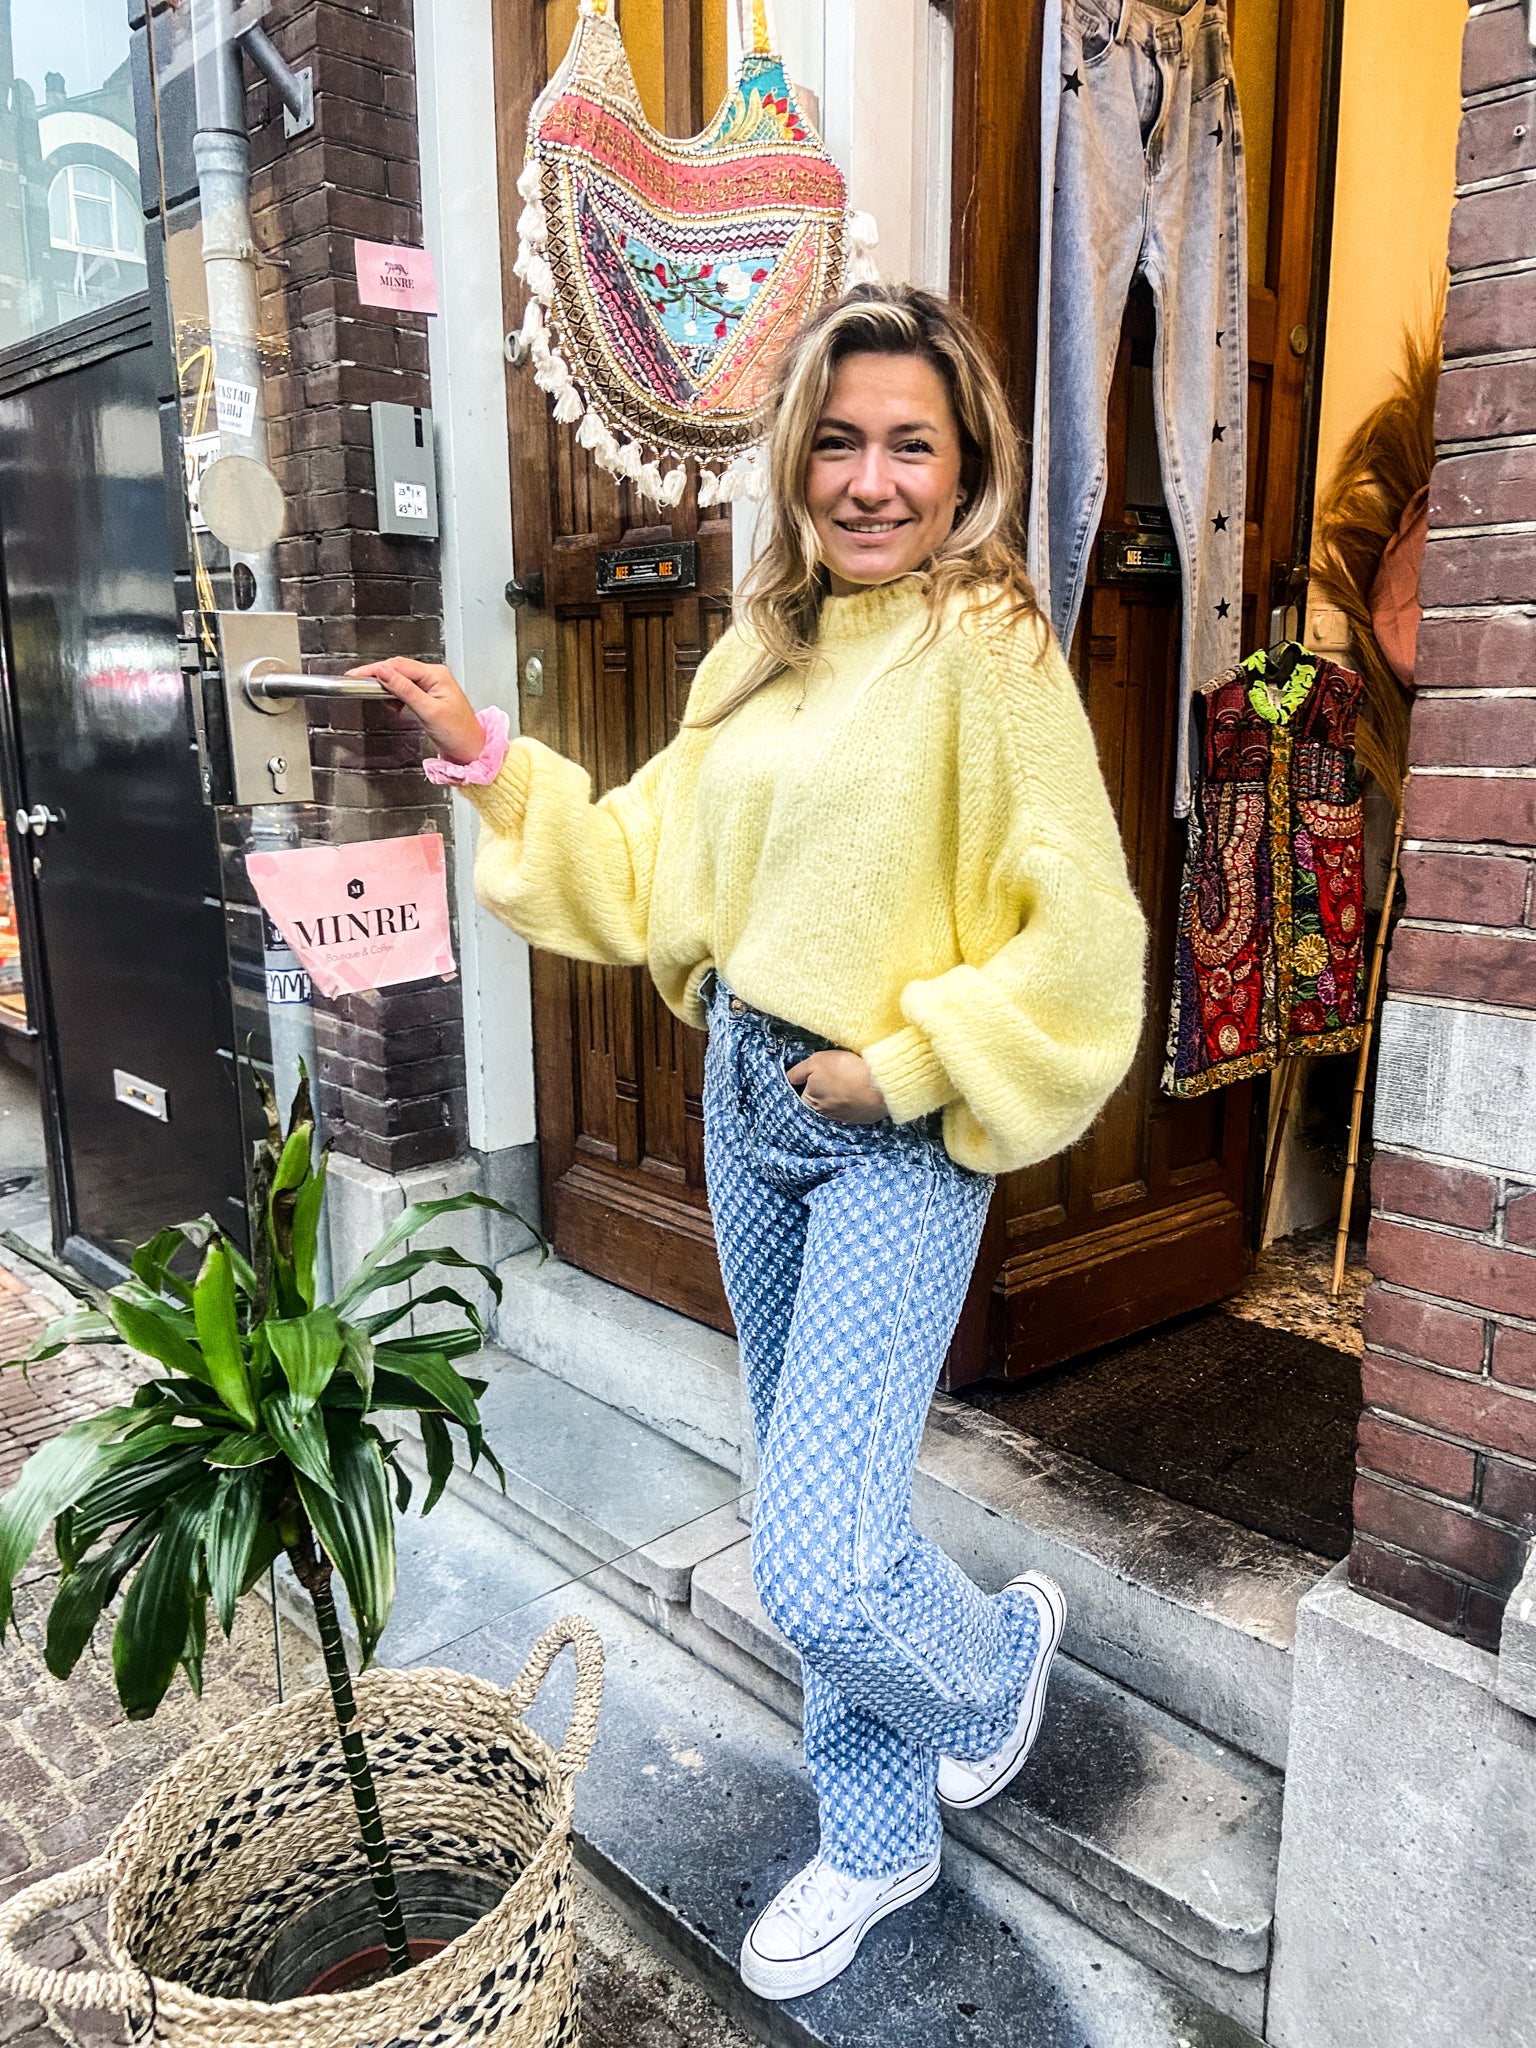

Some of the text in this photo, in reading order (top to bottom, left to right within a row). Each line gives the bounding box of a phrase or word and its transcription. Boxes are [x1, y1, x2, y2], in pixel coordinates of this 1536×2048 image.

[380, 275, 415, 289] MINRE
[1127, 550, 1142, 565] NEE
[615, 565, 629, 579] NEE
[659, 561, 673, 576] NEE
[291, 903, 420, 949] MINRE
[326, 944, 395, 962] Boutique & Coffee
